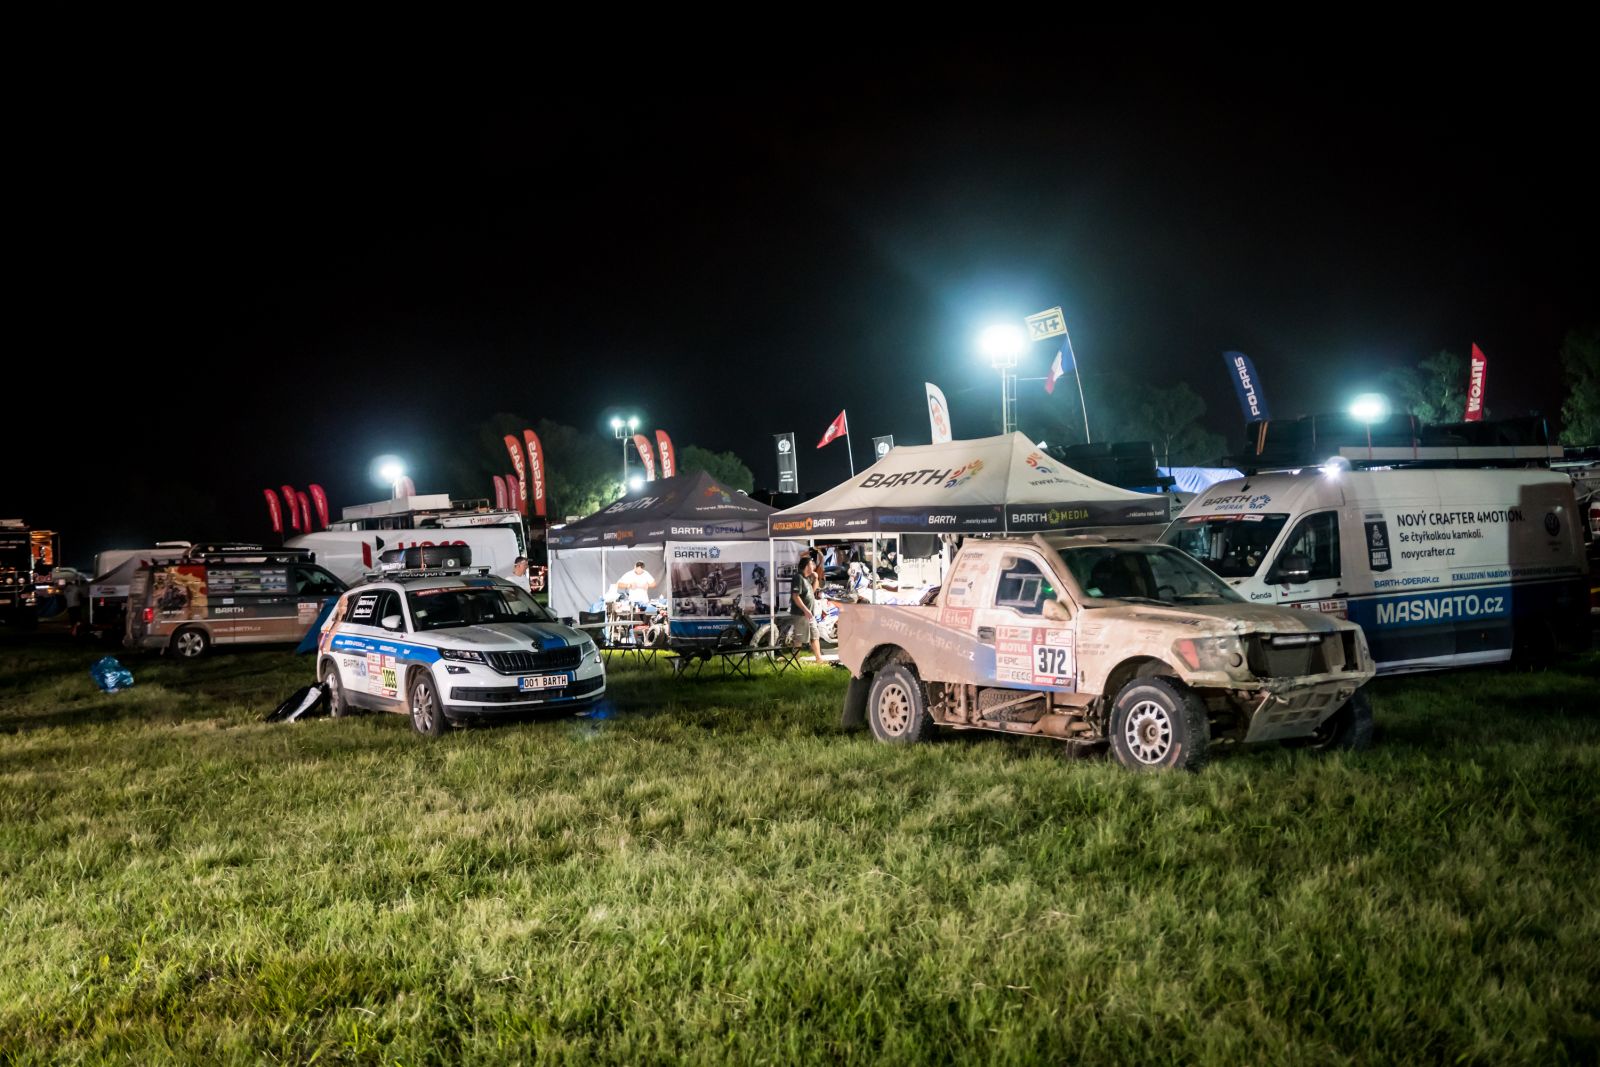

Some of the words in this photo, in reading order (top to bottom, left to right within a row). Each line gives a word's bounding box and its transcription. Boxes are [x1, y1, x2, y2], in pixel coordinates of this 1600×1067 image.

[1234, 355, 1259, 417] POLARIS
[859, 469, 952, 488] BARTH
[1202, 495, 1252, 507] BARTH
[813, 518, 836, 528] BARTH
[928, 515, 957, 524] BARTH
[1012, 514, 1047, 524] BARTH
[1060, 509, 1089, 520] MEDIA
[1396, 510, 1427, 527] NOVÝ
[1429, 511, 1475, 526] CRAFTER
[1477, 510, 1526, 523] 4MOTION.
[671, 526, 703, 535] BARTH
[1399, 532, 1409, 543] Se
[1411, 530, 1451, 544] čtyřkolkou
[1453, 529, 1484, 540] kamkoli.
[674, 551, 708, 559] BARTH
[1401, 547, 1456, 561] novycrafter.cz
[1374, 576, 1440, 588] BARTH-OPERAK.cz
[1250, 592, 1272, 600] Čenda
[1376, 594, 1504, 624] MASNATO.cz
[1038, 647, 1067, 675] 372
[524, 679, 538, 688] 001
[543, 676, 567, 686] BARTH
